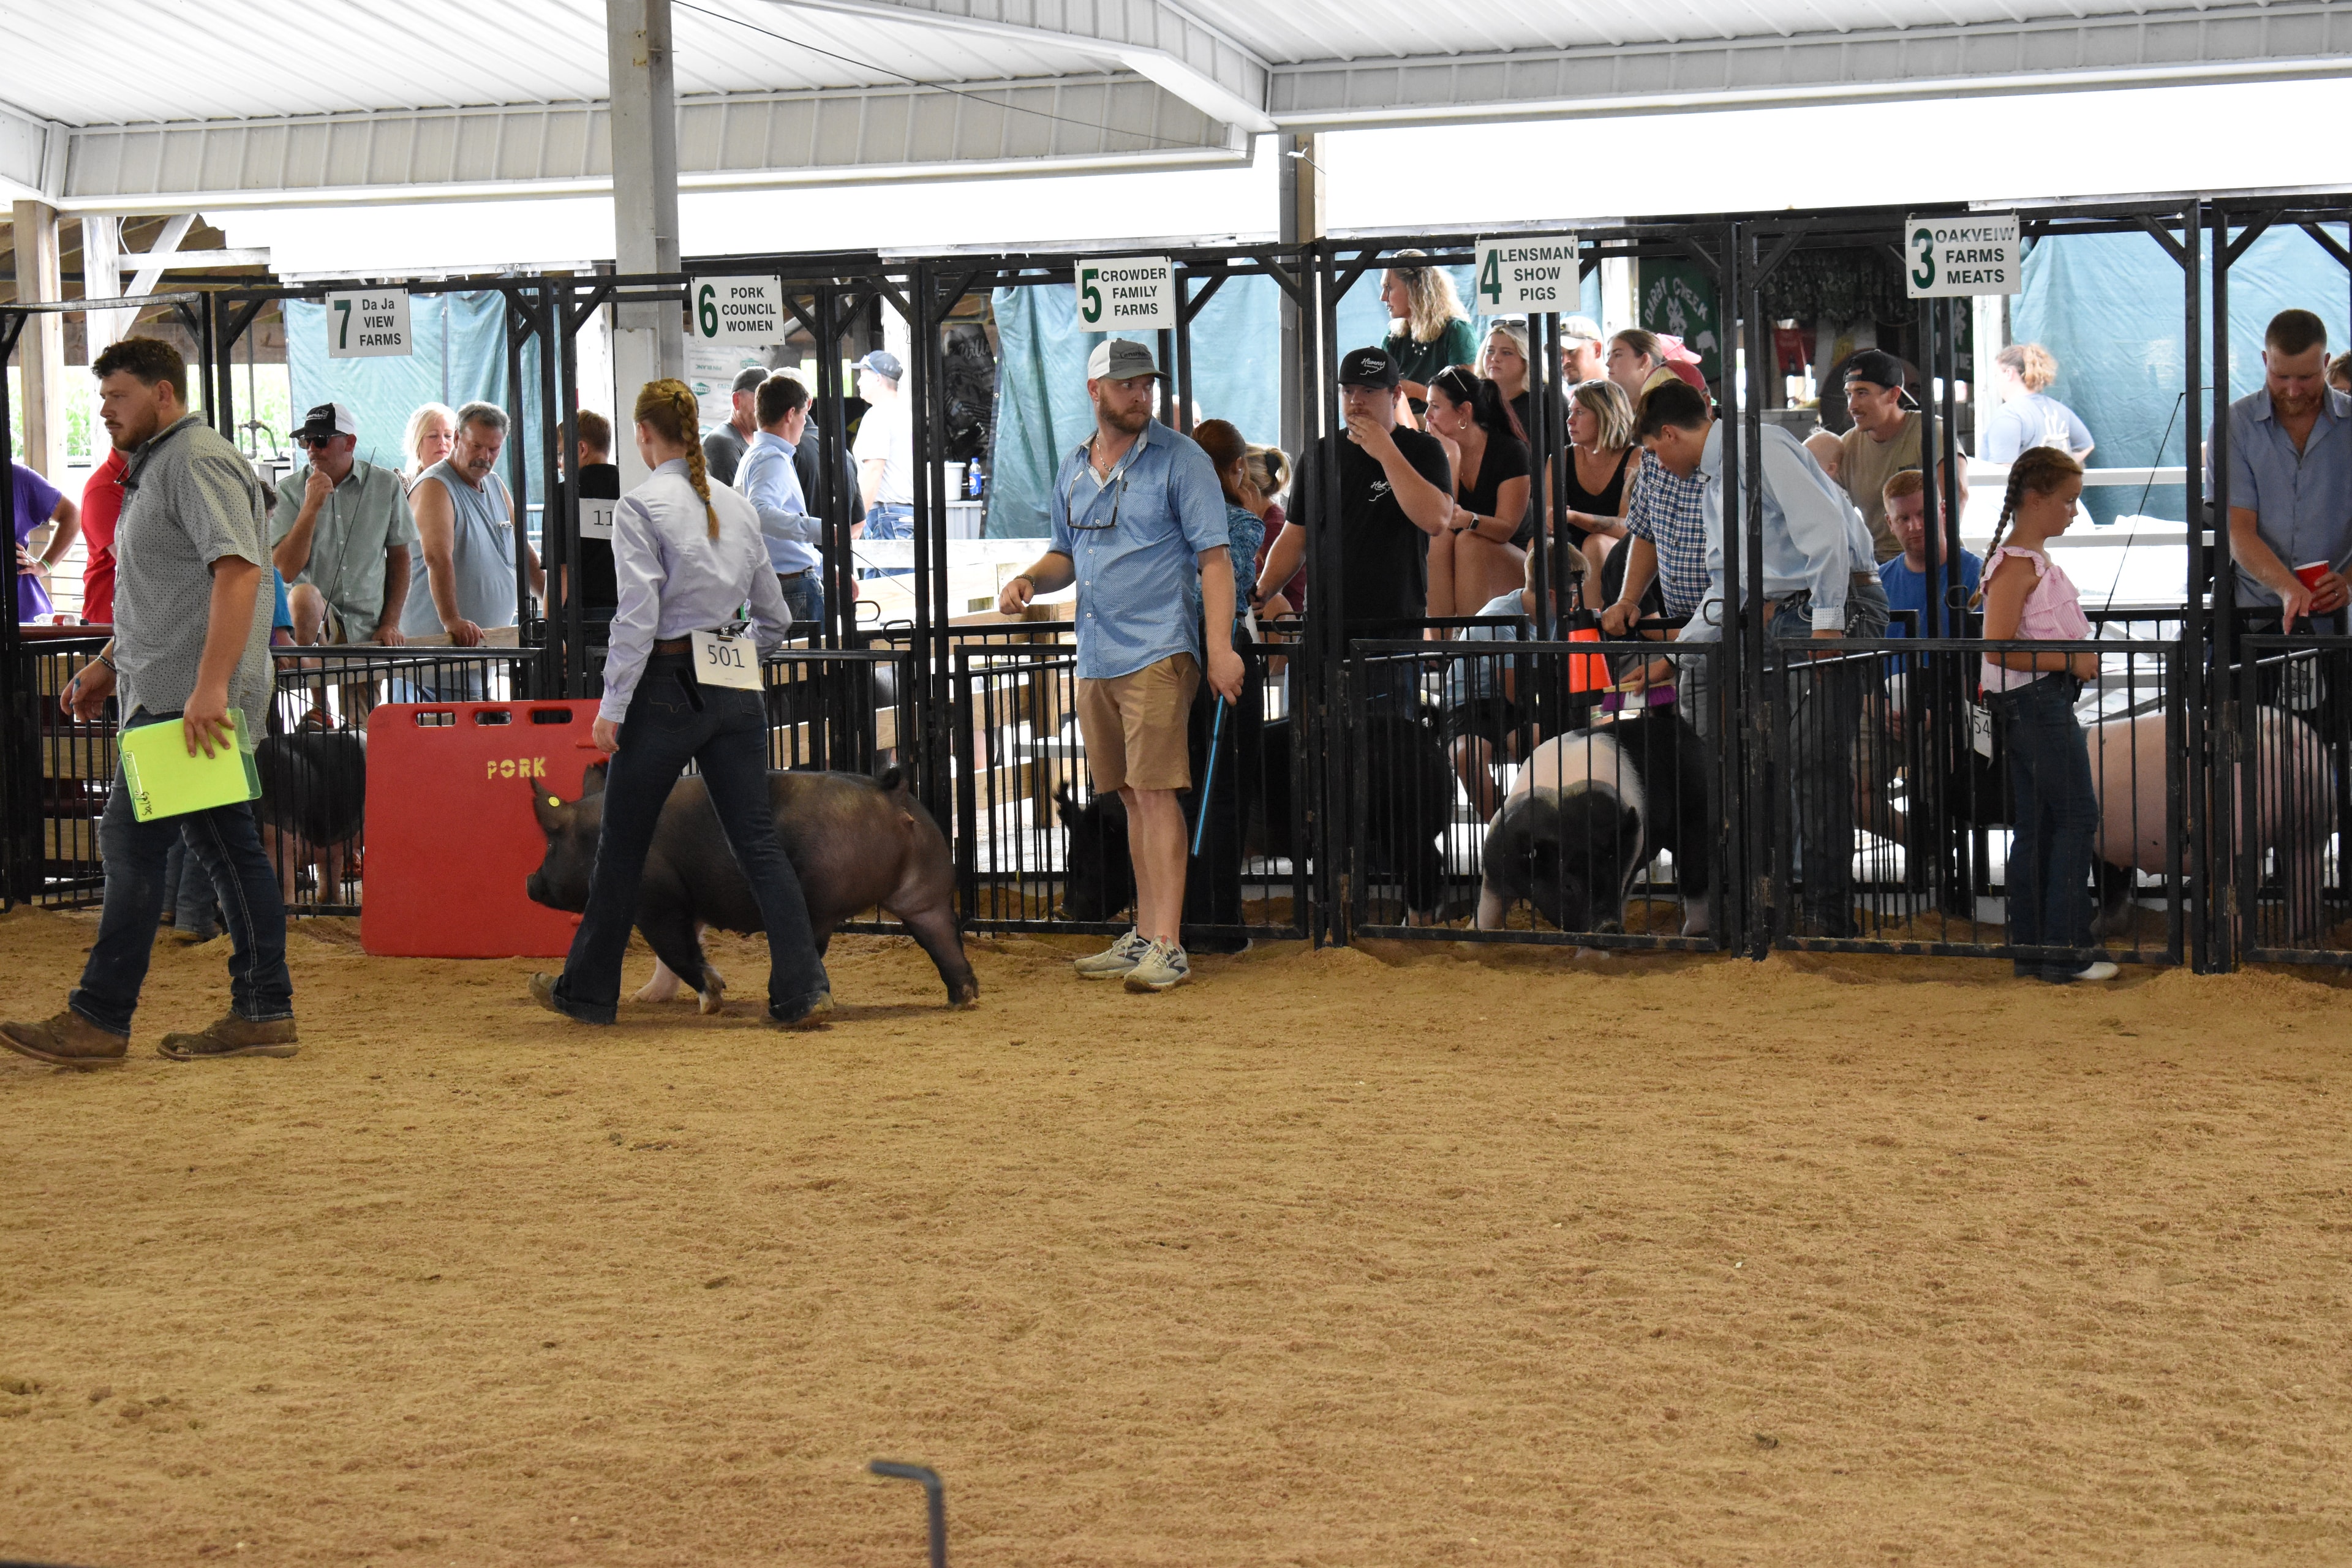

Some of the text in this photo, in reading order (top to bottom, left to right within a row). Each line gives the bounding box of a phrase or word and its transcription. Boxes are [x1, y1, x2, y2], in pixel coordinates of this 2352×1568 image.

[1936, 227, 2015, 243] OAKVEIW
[1499, 246, 1574, 262] LENSMAN
[1912, 228, 1935, 289] 3
[1946, 248, 2004, 263] FARMS
[1101, 268, 1167, 282] CROWDER
[1480, 249, 1502, 304] 4
[1514, 267, 1561, 281] SHOW
[1947, 269, 2004, 284] MEATS
[731, 287, 764, 298] PORK
[1082, 268, 1102, 323] 5
[1112, 285, 1158, 299] FAMILY
[1520, 287, 1556, 301] PIGS
[362, 298, 394, 311] Da Ja
[1645, 277, 1708, 326] DARBY CREEK
[698, 284, 718, 337] 6
[722, 304, 776, 315] COUNCIL
[1114, 303, 1158, 316] FARMS
[334, 299, 352, 349] 7
[364, 315, 394, 328] VIEW
[726, 320, 773, 331] WOMEN
[360, 333, 401, 346] FARMS
[708, 644, 745, 668] 501
[488, 757, 546, 779] PORK
